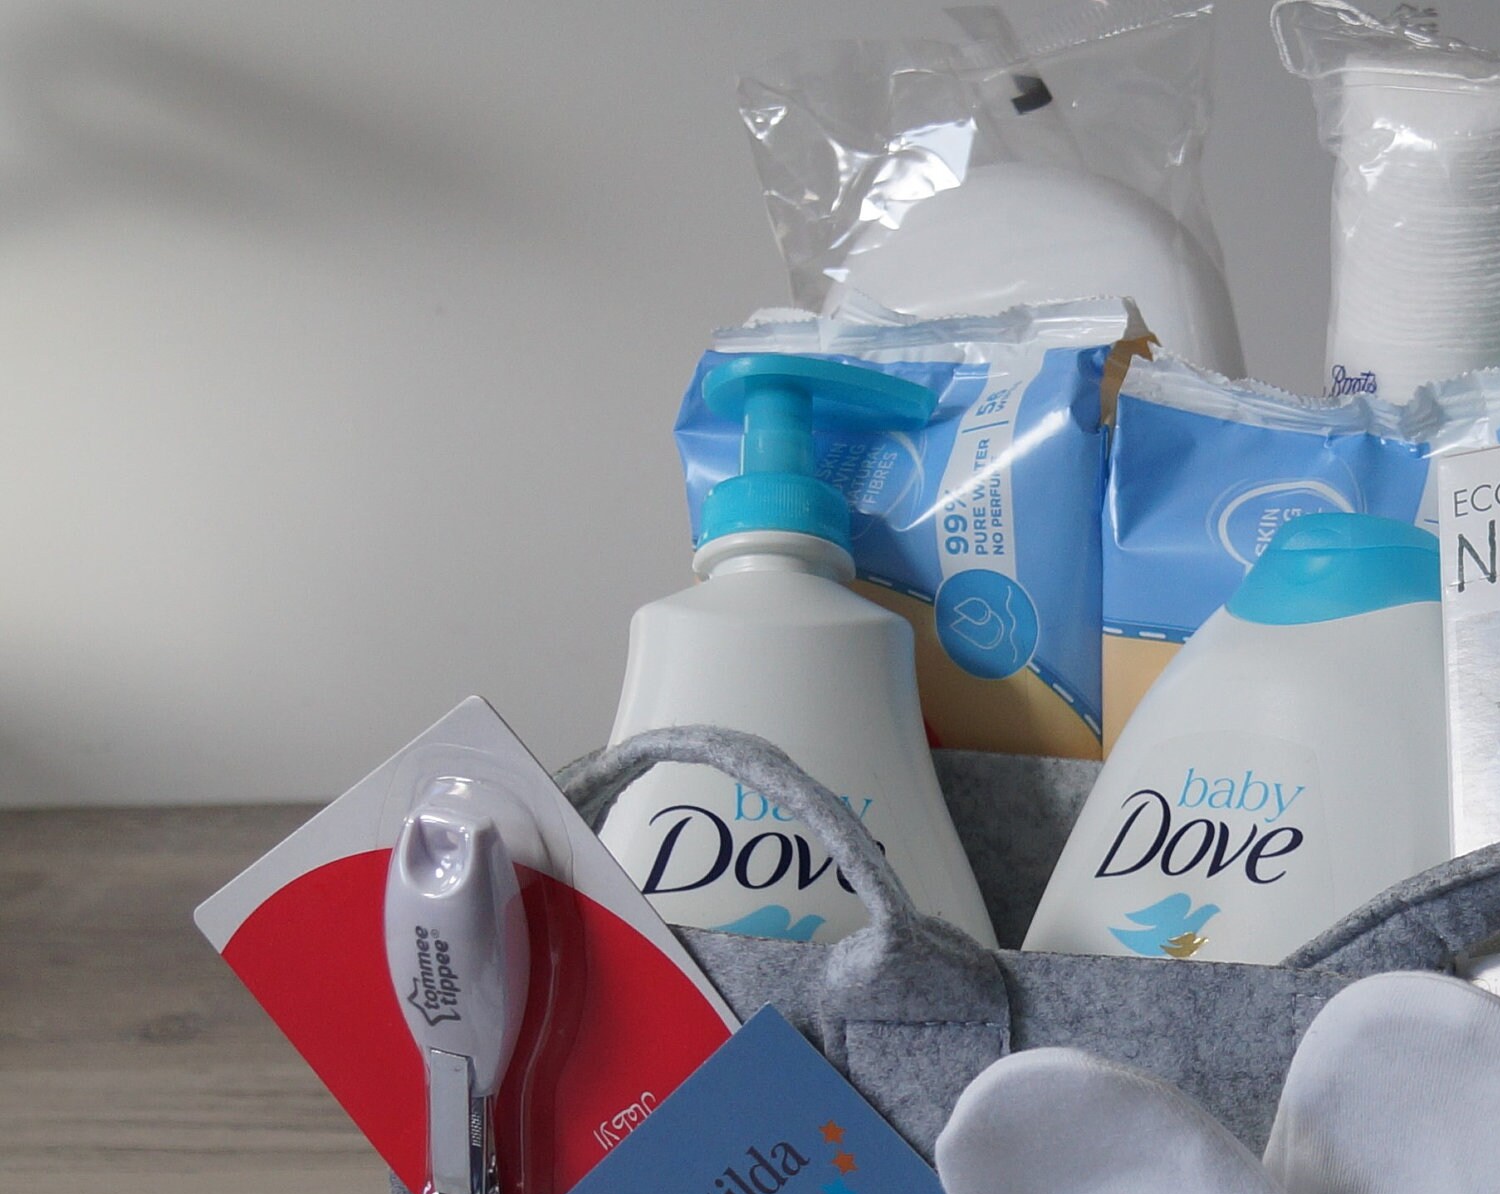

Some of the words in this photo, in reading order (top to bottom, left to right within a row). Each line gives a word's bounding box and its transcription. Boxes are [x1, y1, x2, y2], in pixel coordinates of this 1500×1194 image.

[1328, 364, 1377, 398] Boots
[834, 443, 865, 489] VING
[862, 451, 899, 505] FIBRES
[973, 438, 990, 500] WTER
[989, 470, 1003, 528] PERFU
[973, 508, 988, 556] PURE
[992, 533, 1004, 556] NO
[1254, 507, 1281, 558] SKIN
[734, 783, 873, 822] by
[1177, 768, 1306, 823] baby
[1095, 789, 1304, 885] Dove
[415, 925, 440, 1010] tommee
[434, 940, 462, 1006] tippee
